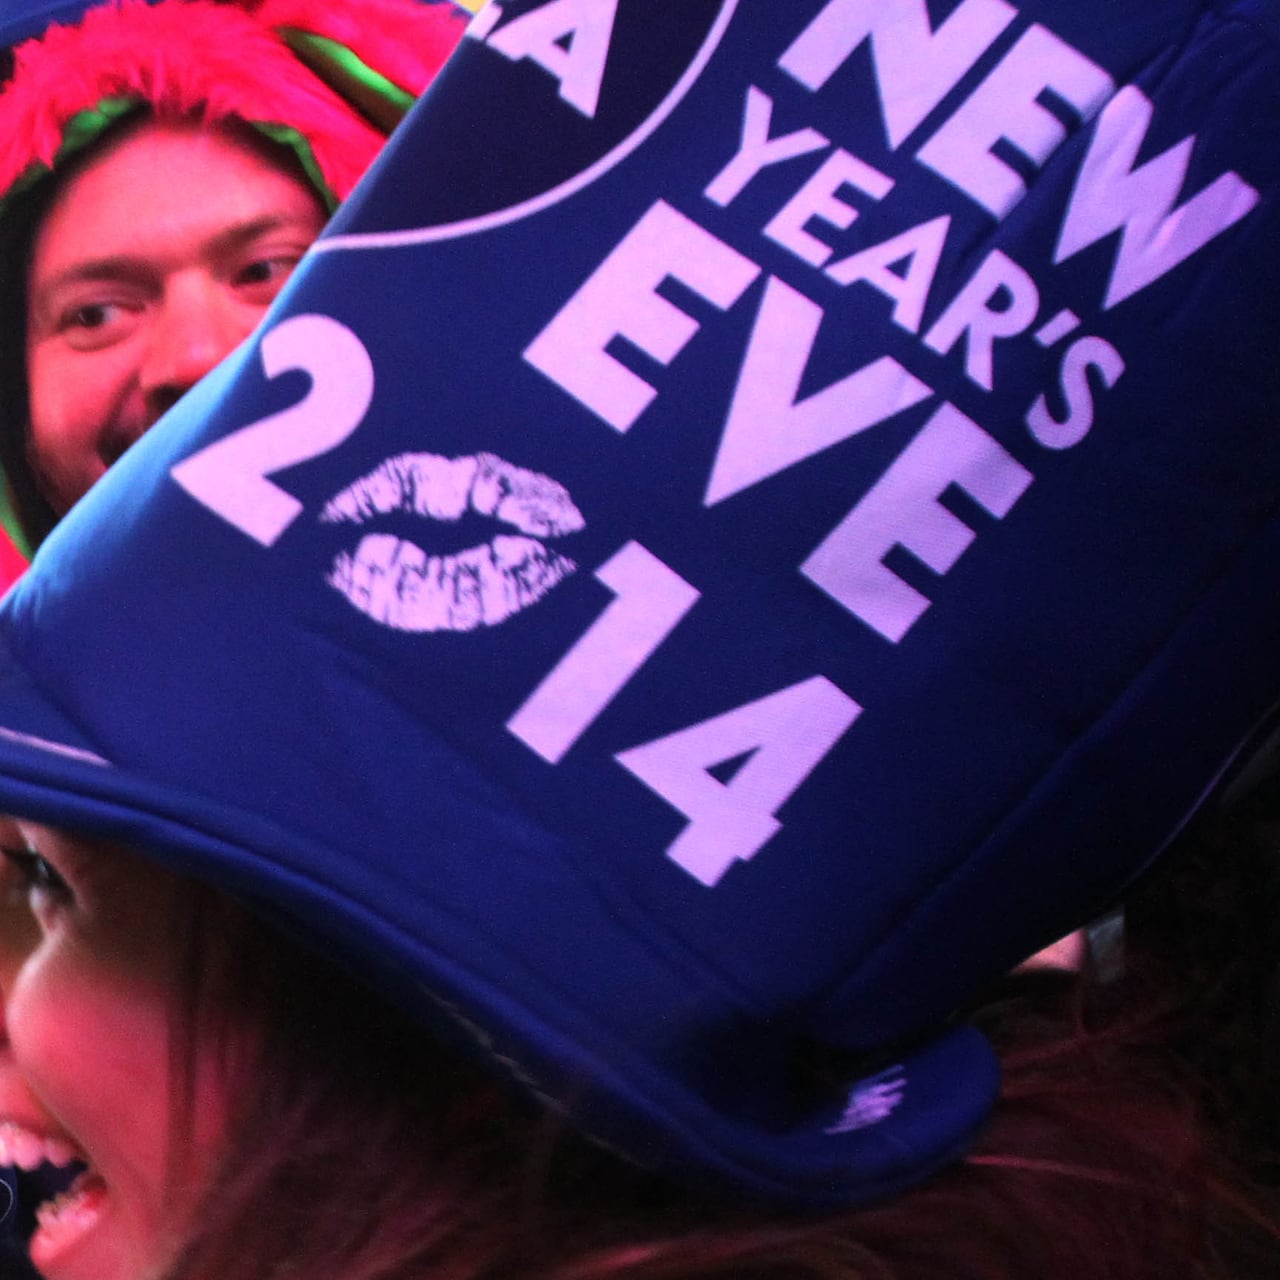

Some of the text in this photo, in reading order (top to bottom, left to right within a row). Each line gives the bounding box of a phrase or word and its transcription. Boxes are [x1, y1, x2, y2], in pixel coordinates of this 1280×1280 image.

[702, 84, 1126, 451] YEAR'S
[776, 0, 1260, 310] NEW
[520, 198, 1035, 645] EVE
